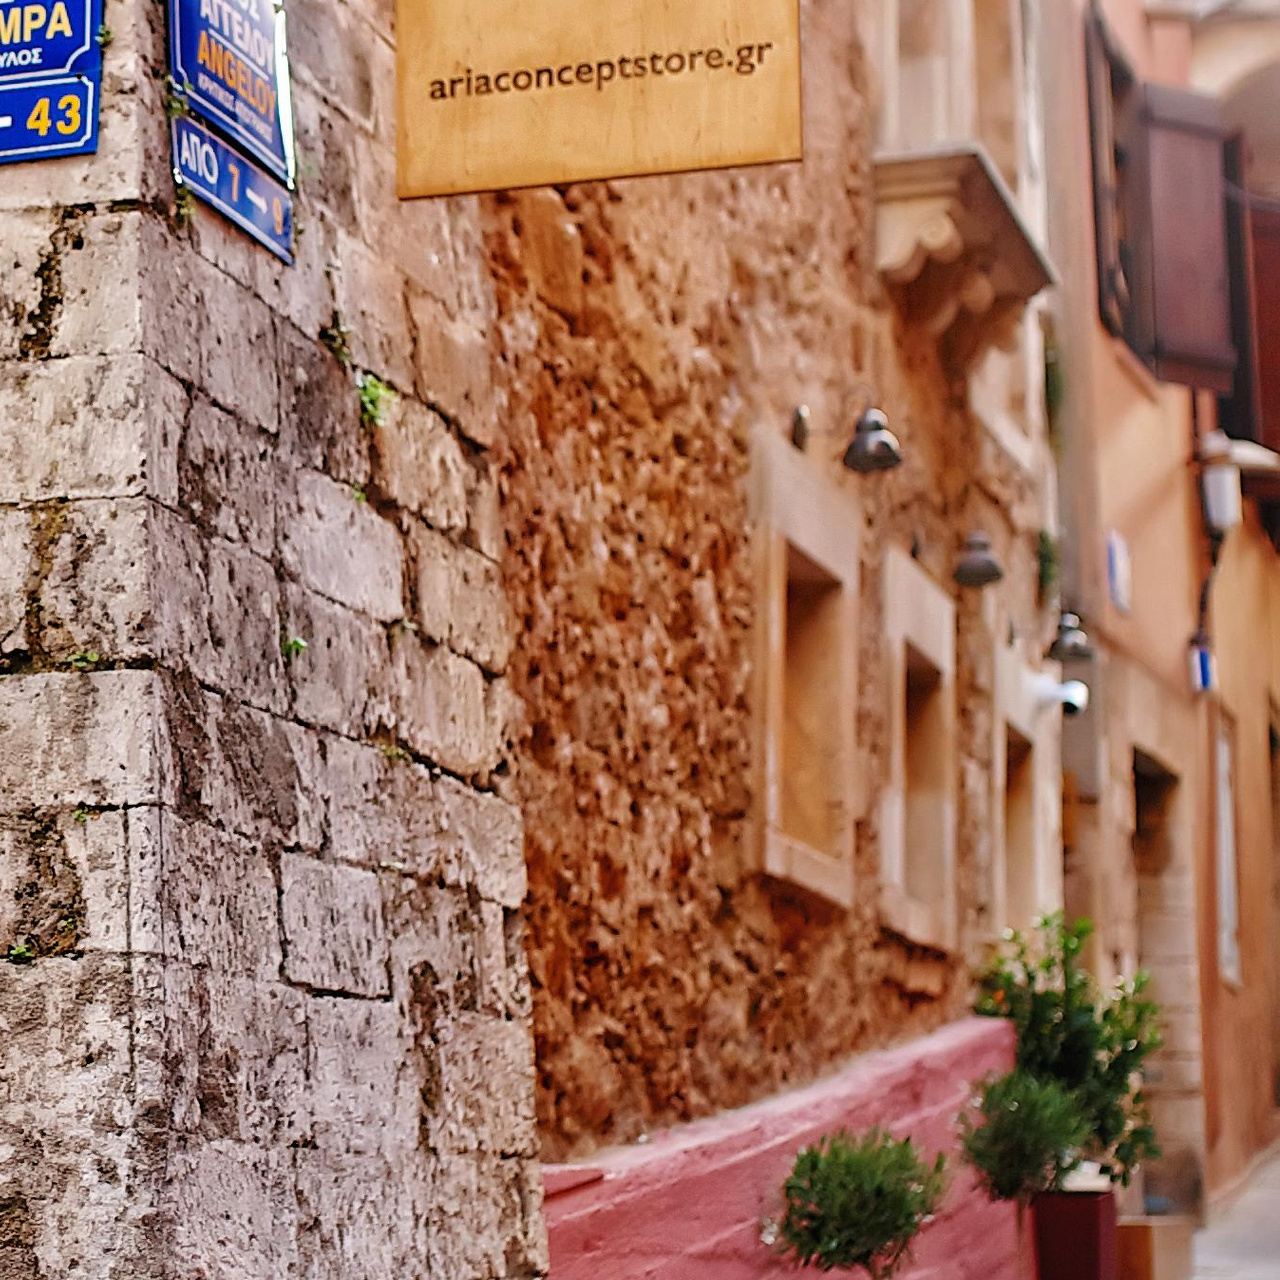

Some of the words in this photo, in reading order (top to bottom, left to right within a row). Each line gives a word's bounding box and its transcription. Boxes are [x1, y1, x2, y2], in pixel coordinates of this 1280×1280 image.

[197, 30, 277, 124] ANGELOY
[428, 38, 774, 101] ariaconceptstore.gr
[26, 94, 82, 137] 43
[180, 129, 219, 185] ΑΠΟ
[229, 163, 240, 203] 7
